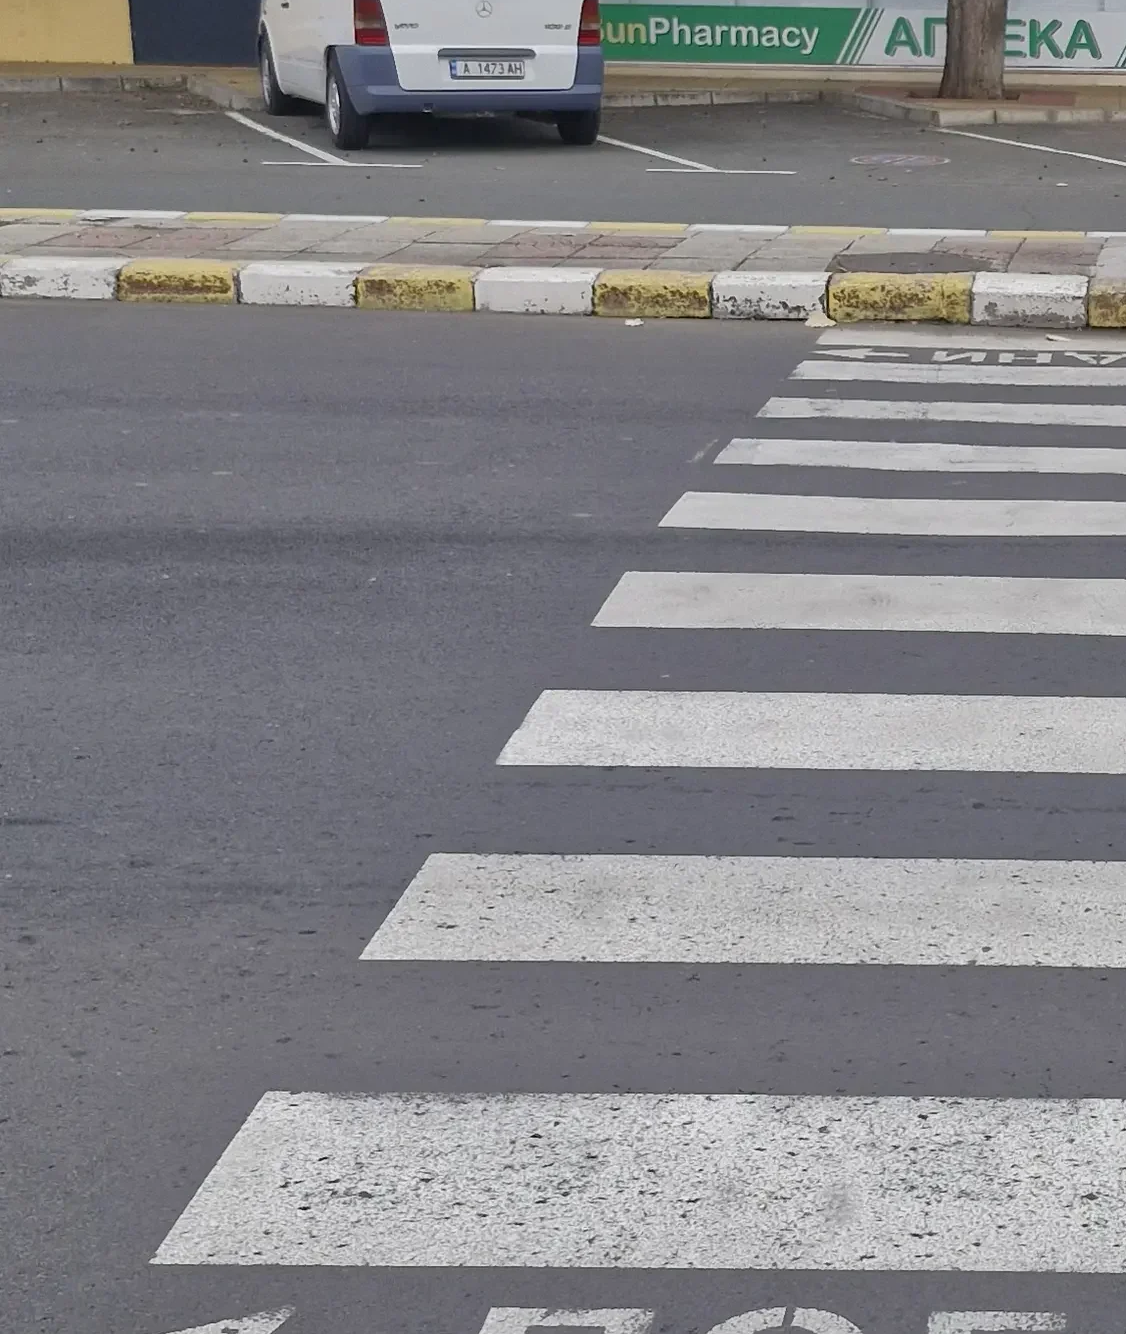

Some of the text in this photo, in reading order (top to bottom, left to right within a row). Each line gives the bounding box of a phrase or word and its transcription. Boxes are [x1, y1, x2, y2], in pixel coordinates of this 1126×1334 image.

[884, 16, 1102, 59] АПЕКА
[463, 63, 523, 74] A 1473 AH
